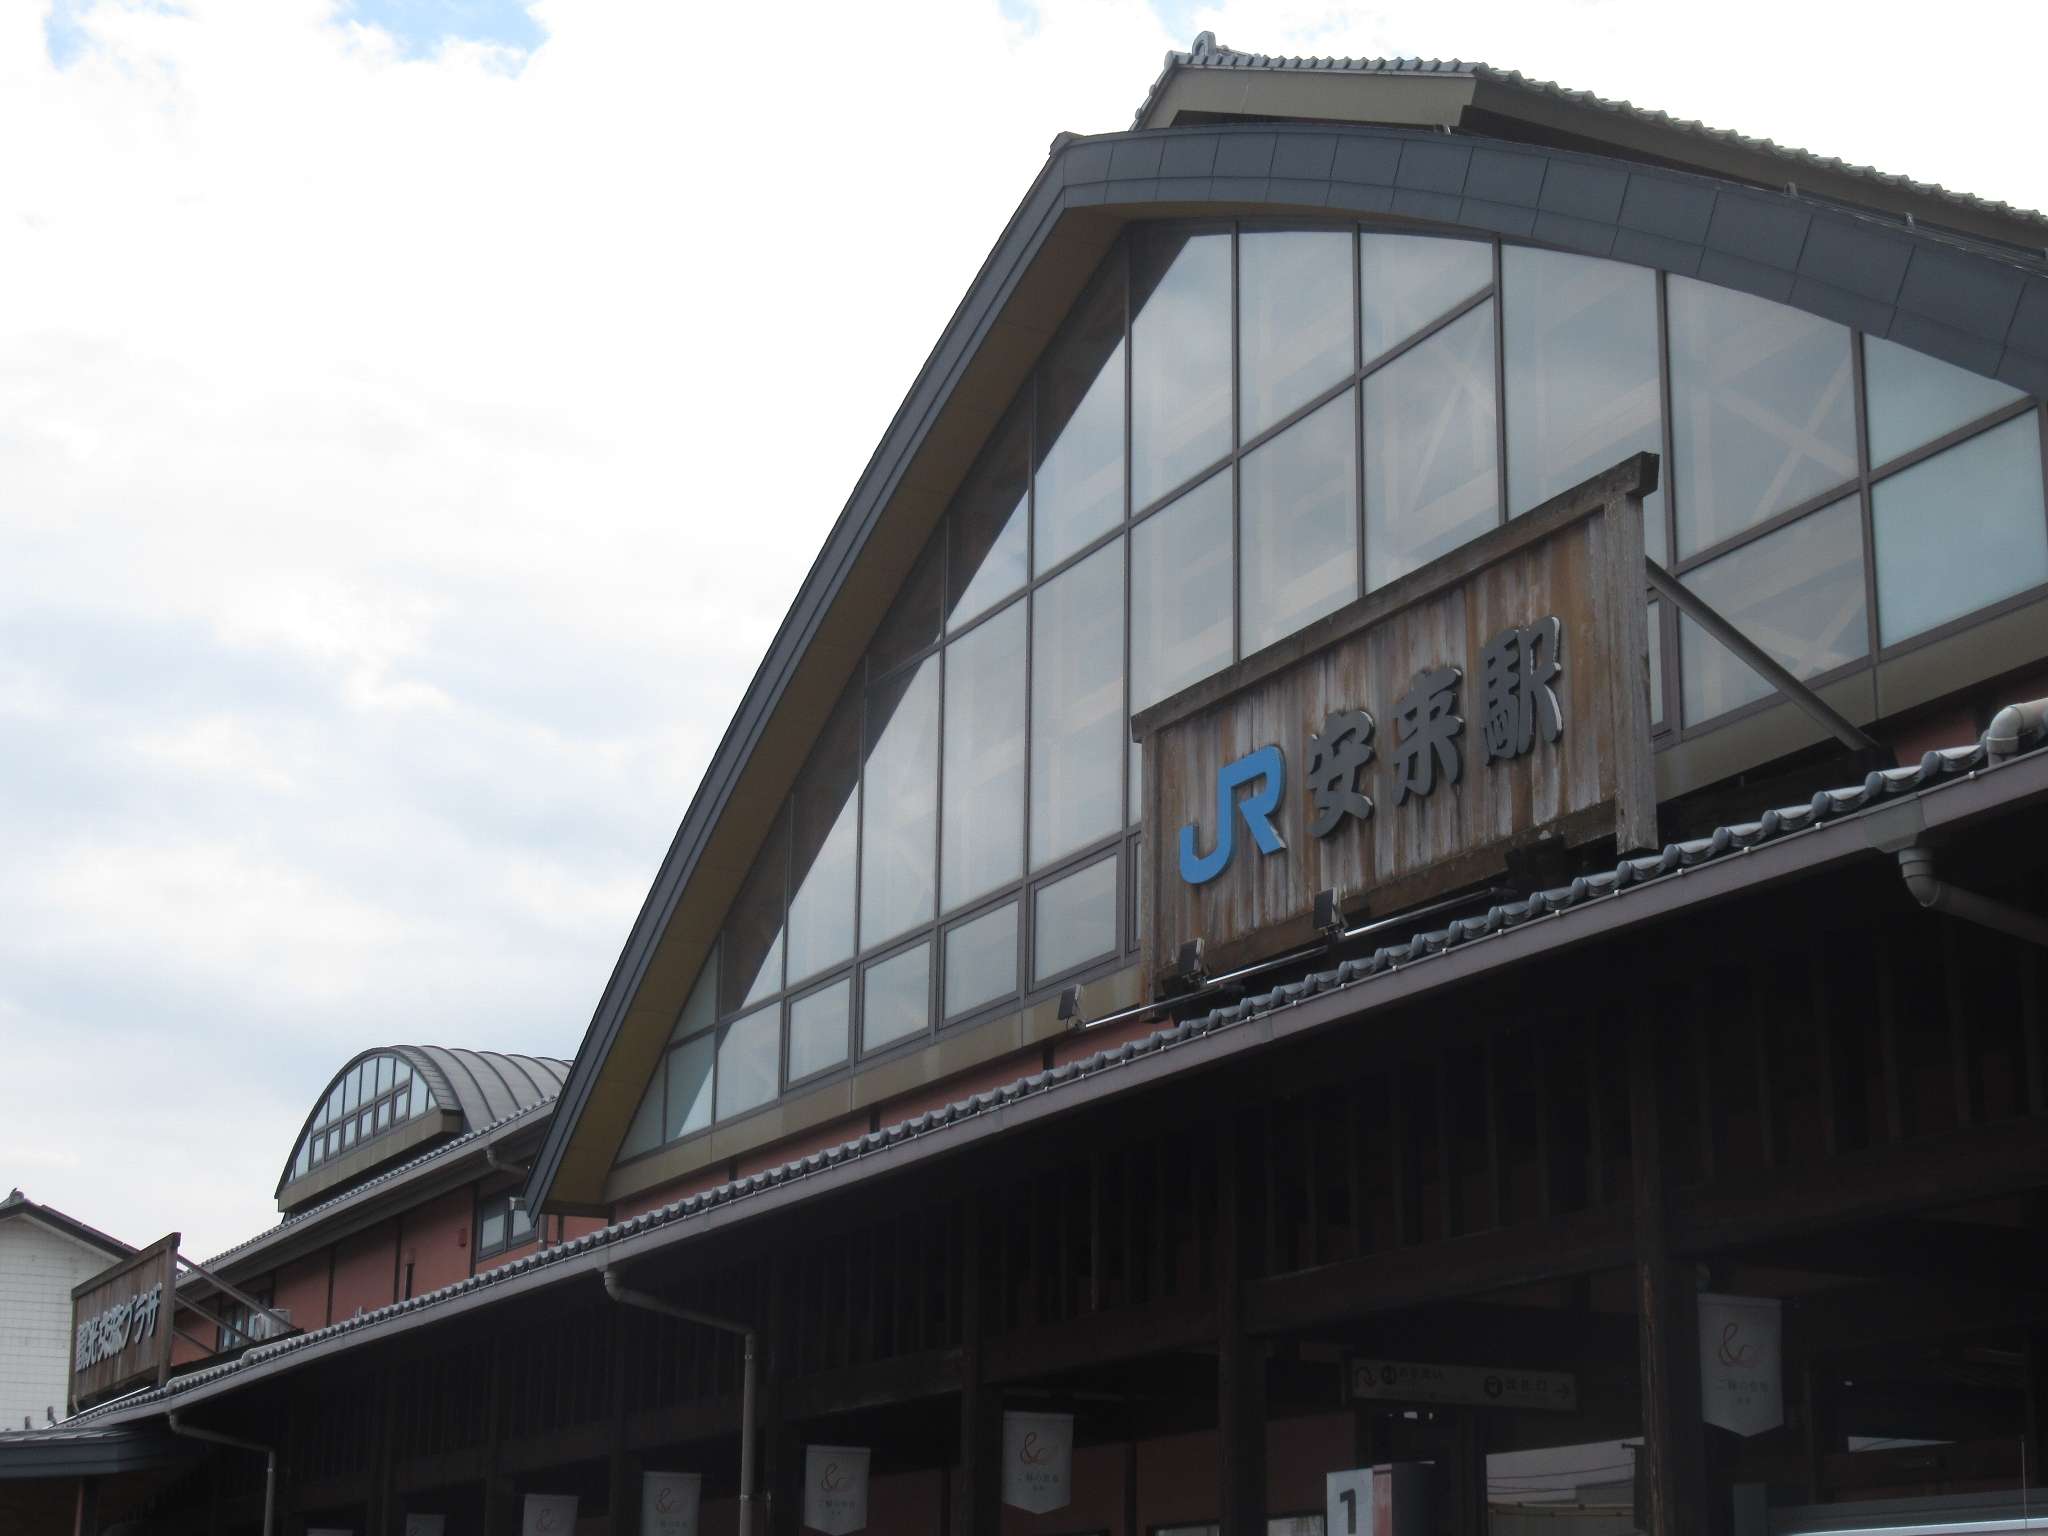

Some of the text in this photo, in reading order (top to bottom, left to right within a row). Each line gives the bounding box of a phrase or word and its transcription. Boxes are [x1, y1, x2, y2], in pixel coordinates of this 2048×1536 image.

[1178, 615, 1564, 886] JR 安来駅
[1339, 1488, 1357, 1535] 1
